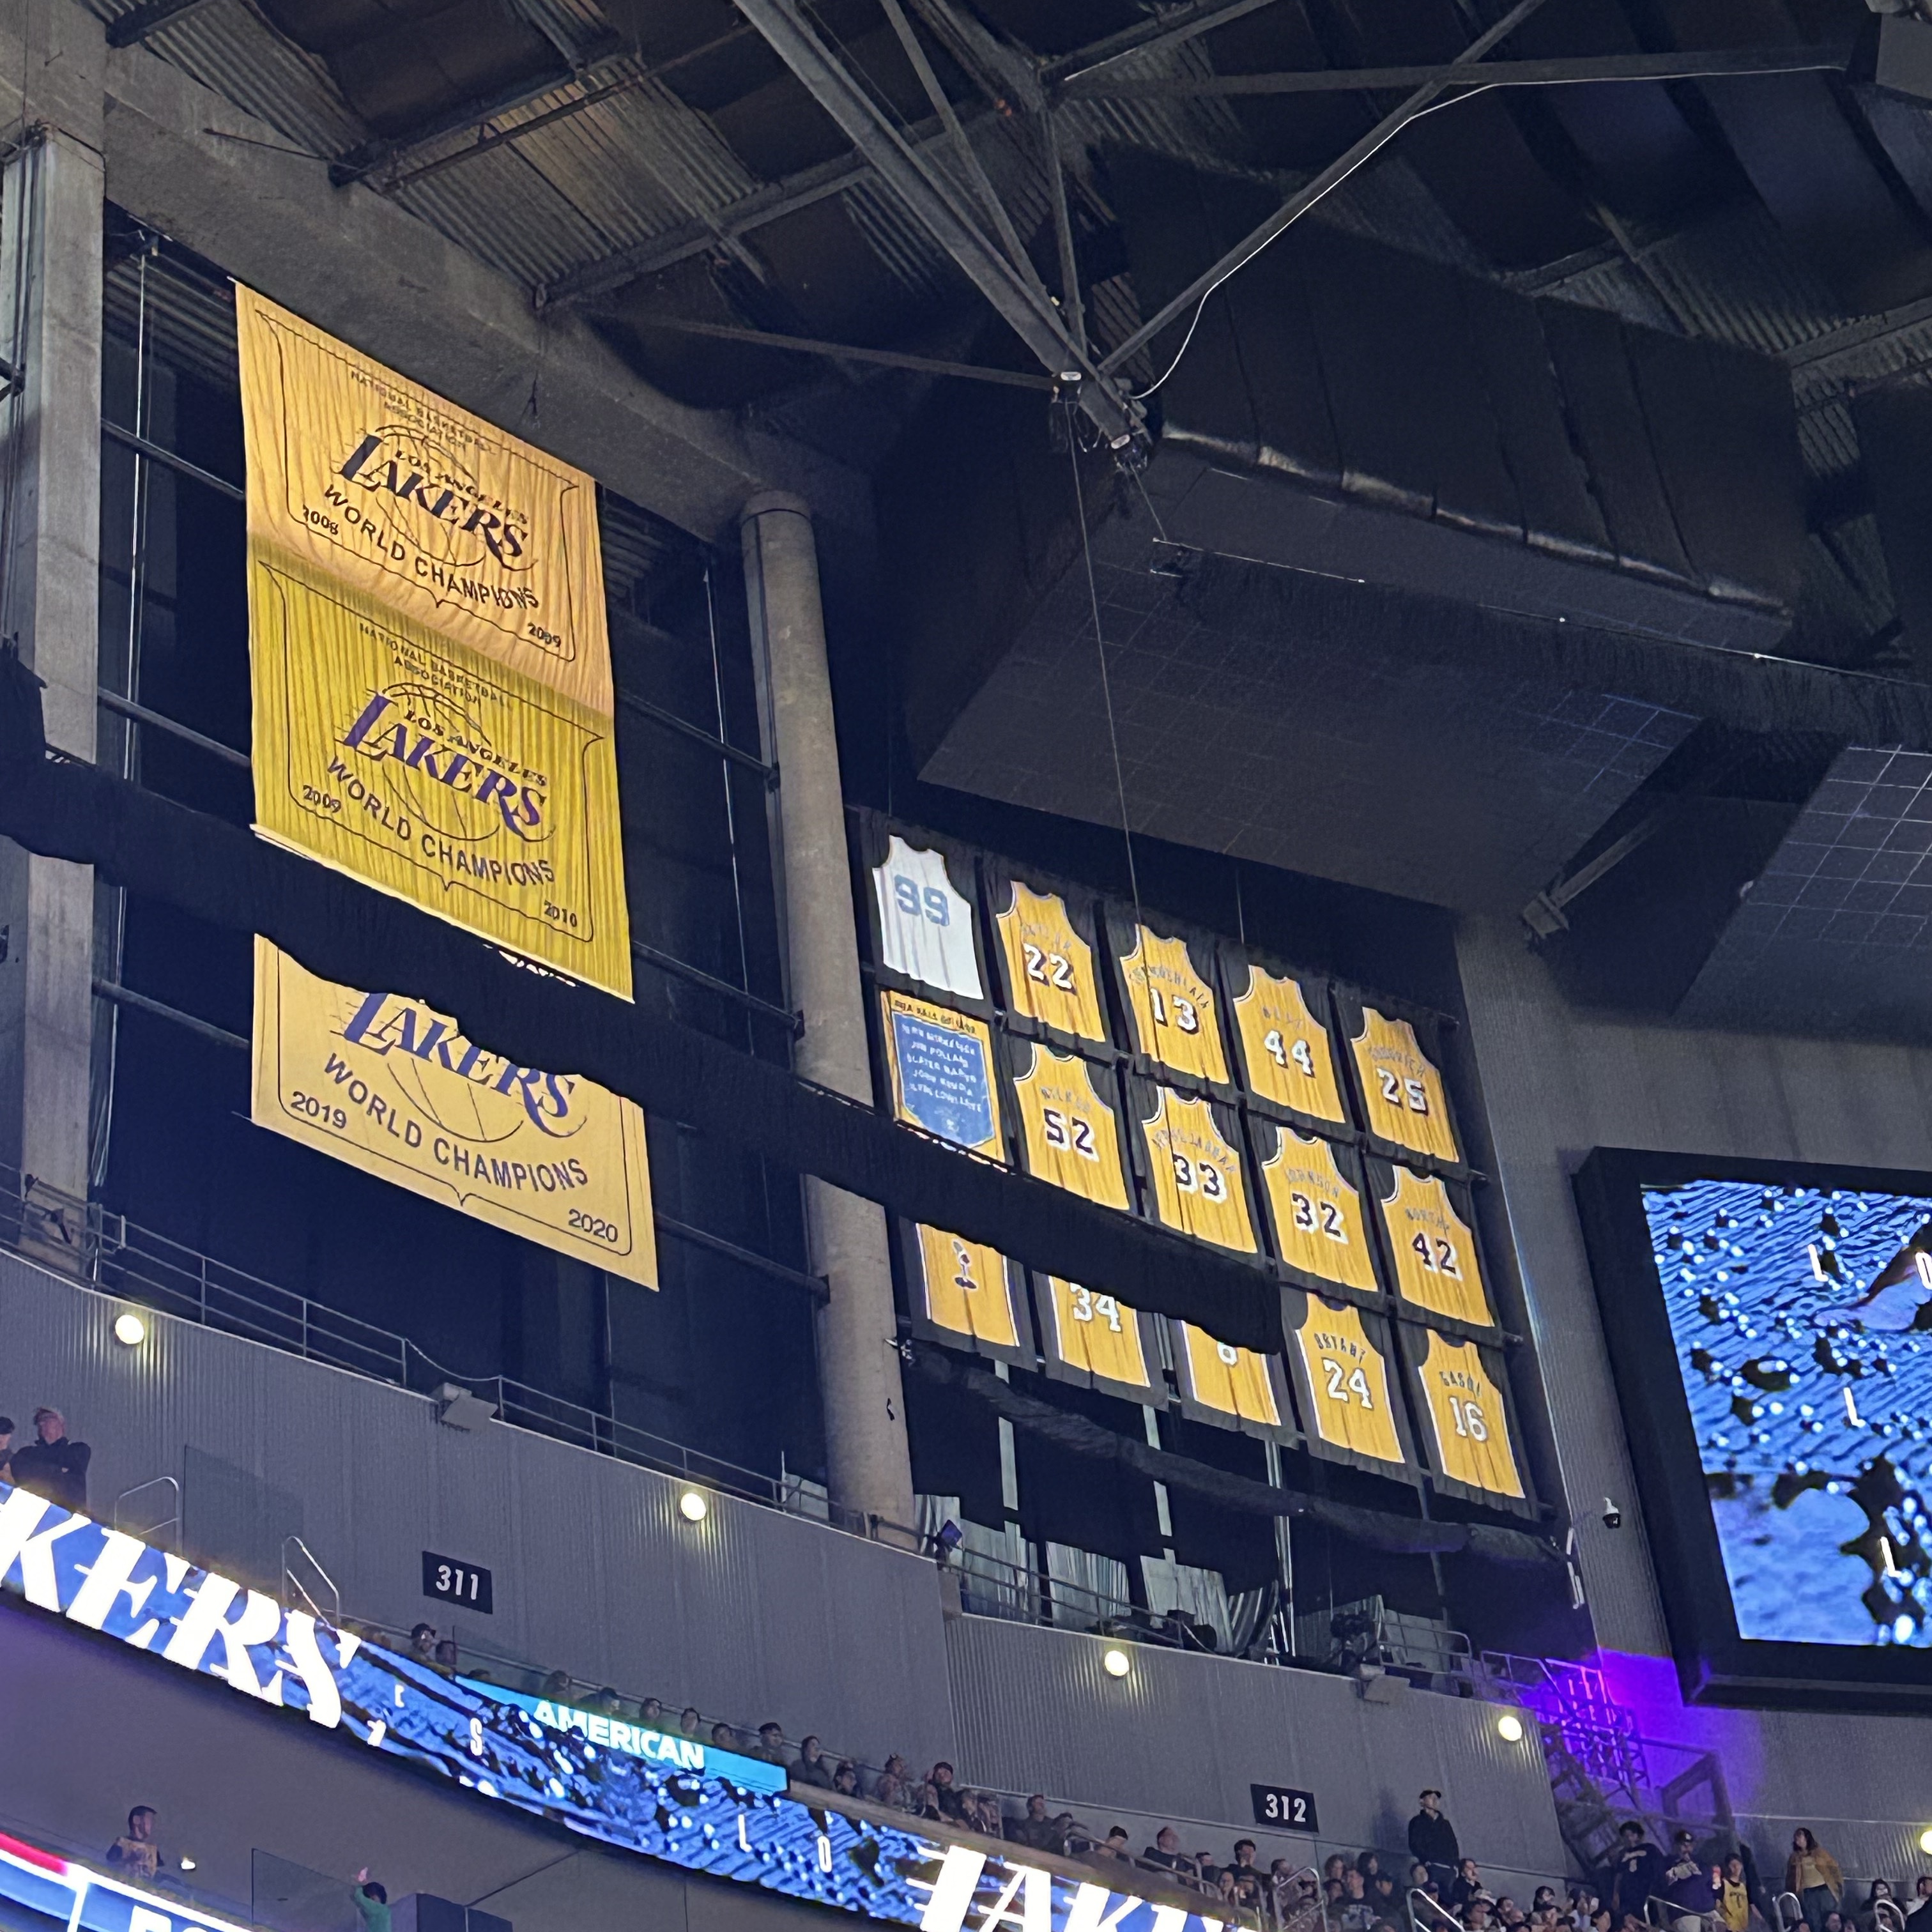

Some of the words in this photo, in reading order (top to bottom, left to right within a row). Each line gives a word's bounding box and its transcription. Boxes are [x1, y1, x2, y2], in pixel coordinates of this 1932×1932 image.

[330, 433, 539, 572] LAKERS
[325, 485, 406, 562] WORLD
[415, 560, 539, 610] CHAMPIONS
[335, 694, 556, 843] LAKERS
[404, 710, 445, 736] LOS
[447, 734, 548, 788] ANGELES
[302, 784, 342, 814] 2009
[326, 756, 413, 841] WORLD
[421, 834, 555, 887] CHAMPIONS
[543, 900, 579, 928] 2010
[894, 873, 950, 927] 99
[1022, 942, 1077, 996] 22
[1149, 987, 1200, 1036] 13
[329, 992, 588, 1138] LAKERS
[1264, 1029, 1316, 1079] 44
[290, 1090, 348, 1130] 2019
[1376, 1068, 1429, 1117] 25
[324, 1052, 422, 1148] WORLD
[433, 1137, 589, 1193] CHAMPIONS
[1043, 1107, 1100, 1163] 52
[1172, 1152, 1228, 1204] 33
[568, 1208, 620, 1244] 2020
[1291, 1190, 1349, 1245] 32
[1411, 1232, 1463, 1282] 42
[1070, 1282, 1123, 1333] 34
[1321, 1356, 1375, 1412] 24
[1448, 1395, 1489, 1443] 16
[436, 1565, 479, 1601] 311
[533, 1699, 705, 1772] AMERICAN
[1265, 1793, 1308, 1823] 312
